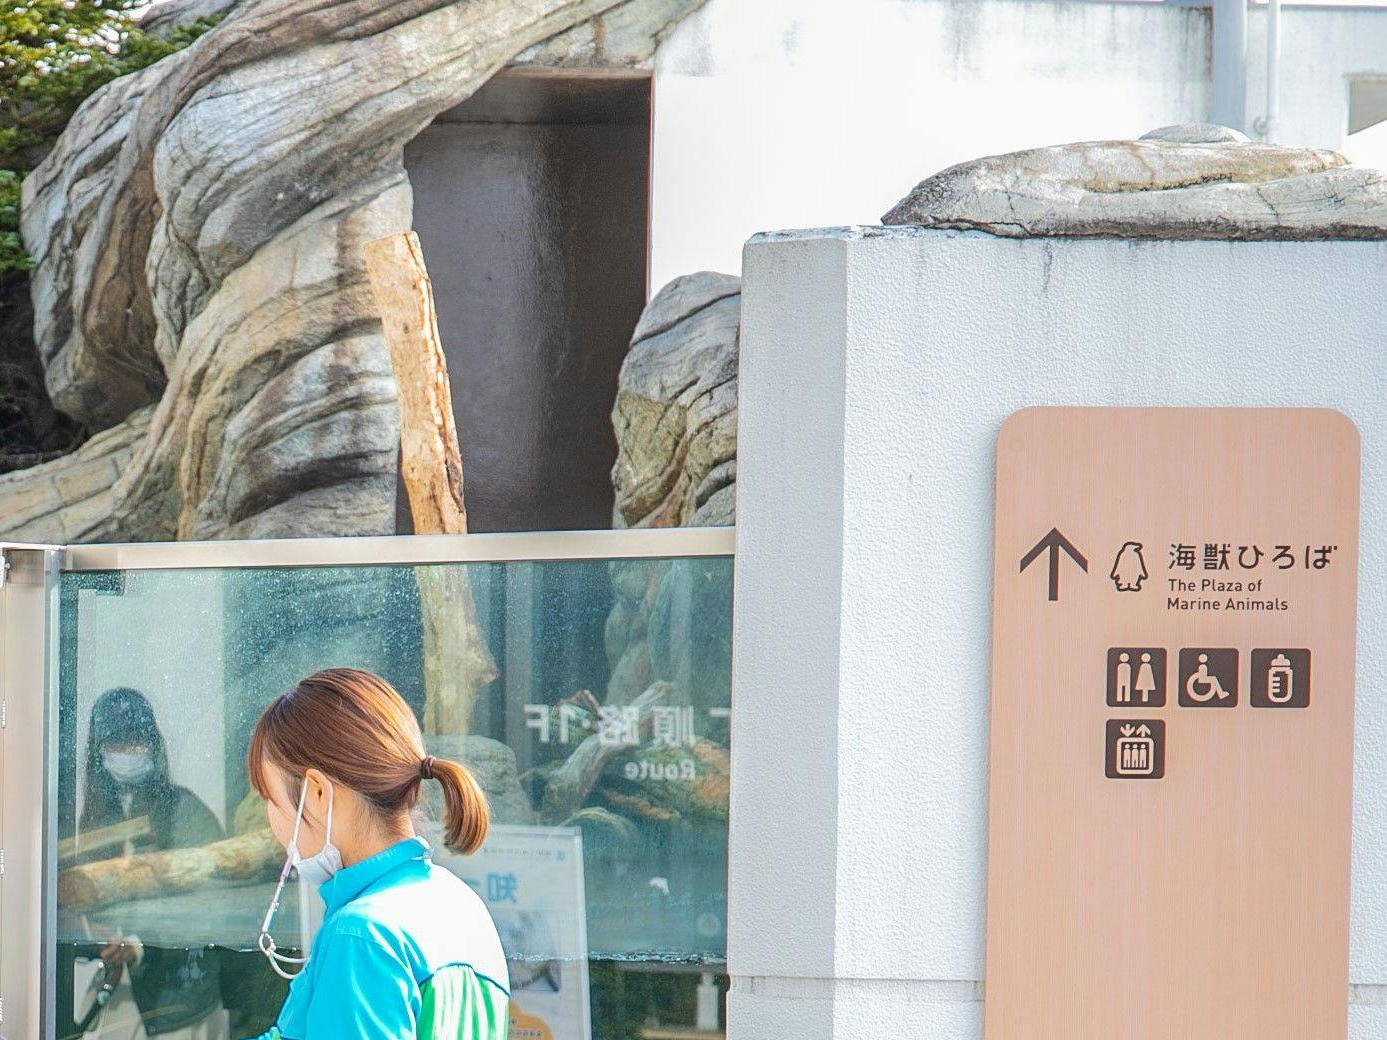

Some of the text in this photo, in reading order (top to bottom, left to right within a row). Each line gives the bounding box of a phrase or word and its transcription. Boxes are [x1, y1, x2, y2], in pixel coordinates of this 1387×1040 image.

[1168, 543, 1338, 571] 海獣ひろば
[1168, 578, 1263, 592] The Plaza of
[1167, 597, 1289, 611] Marine Animals
